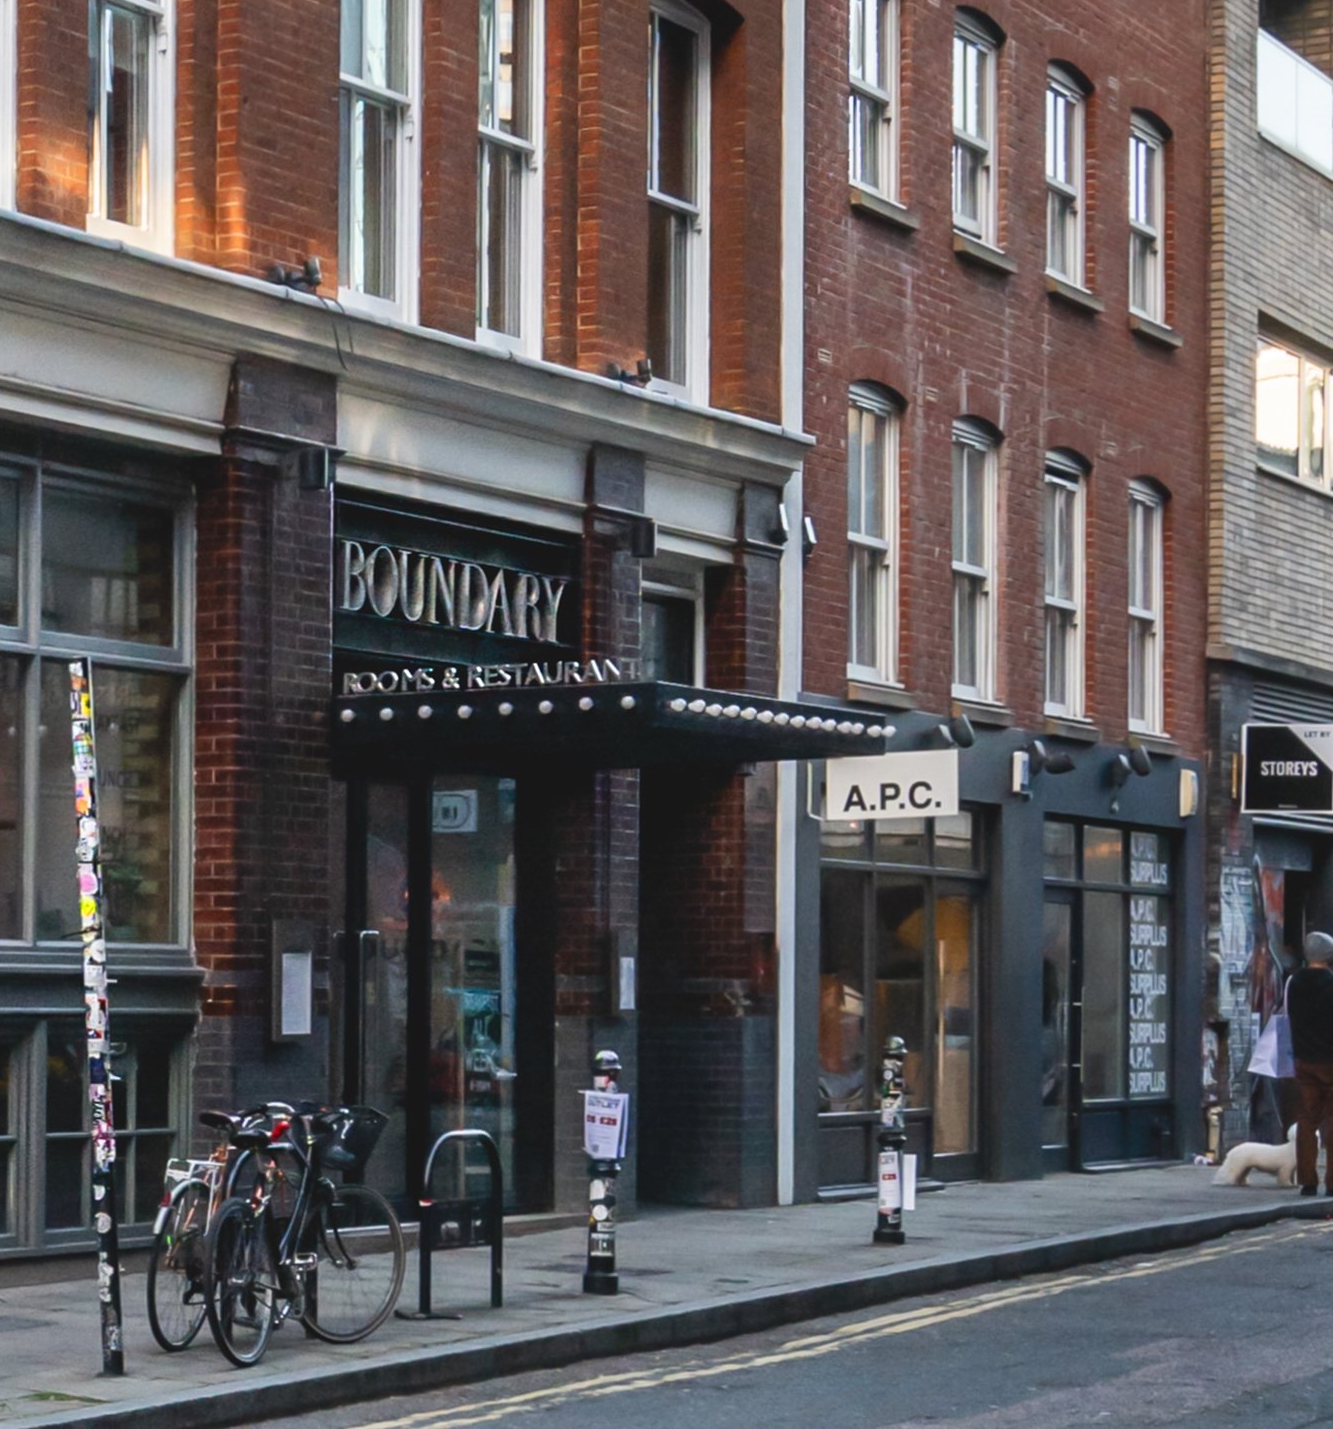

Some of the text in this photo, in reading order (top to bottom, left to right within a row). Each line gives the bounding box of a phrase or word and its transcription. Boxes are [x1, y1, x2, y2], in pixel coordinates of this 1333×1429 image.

[339, 540, 567, 643] BOUNDARY
[342, 657, 642, 694] ROOMS & RESTAURANT
[1260, 760, 1319, 777] STOREYS
[843, 780, 942, 812] A.P.C.
